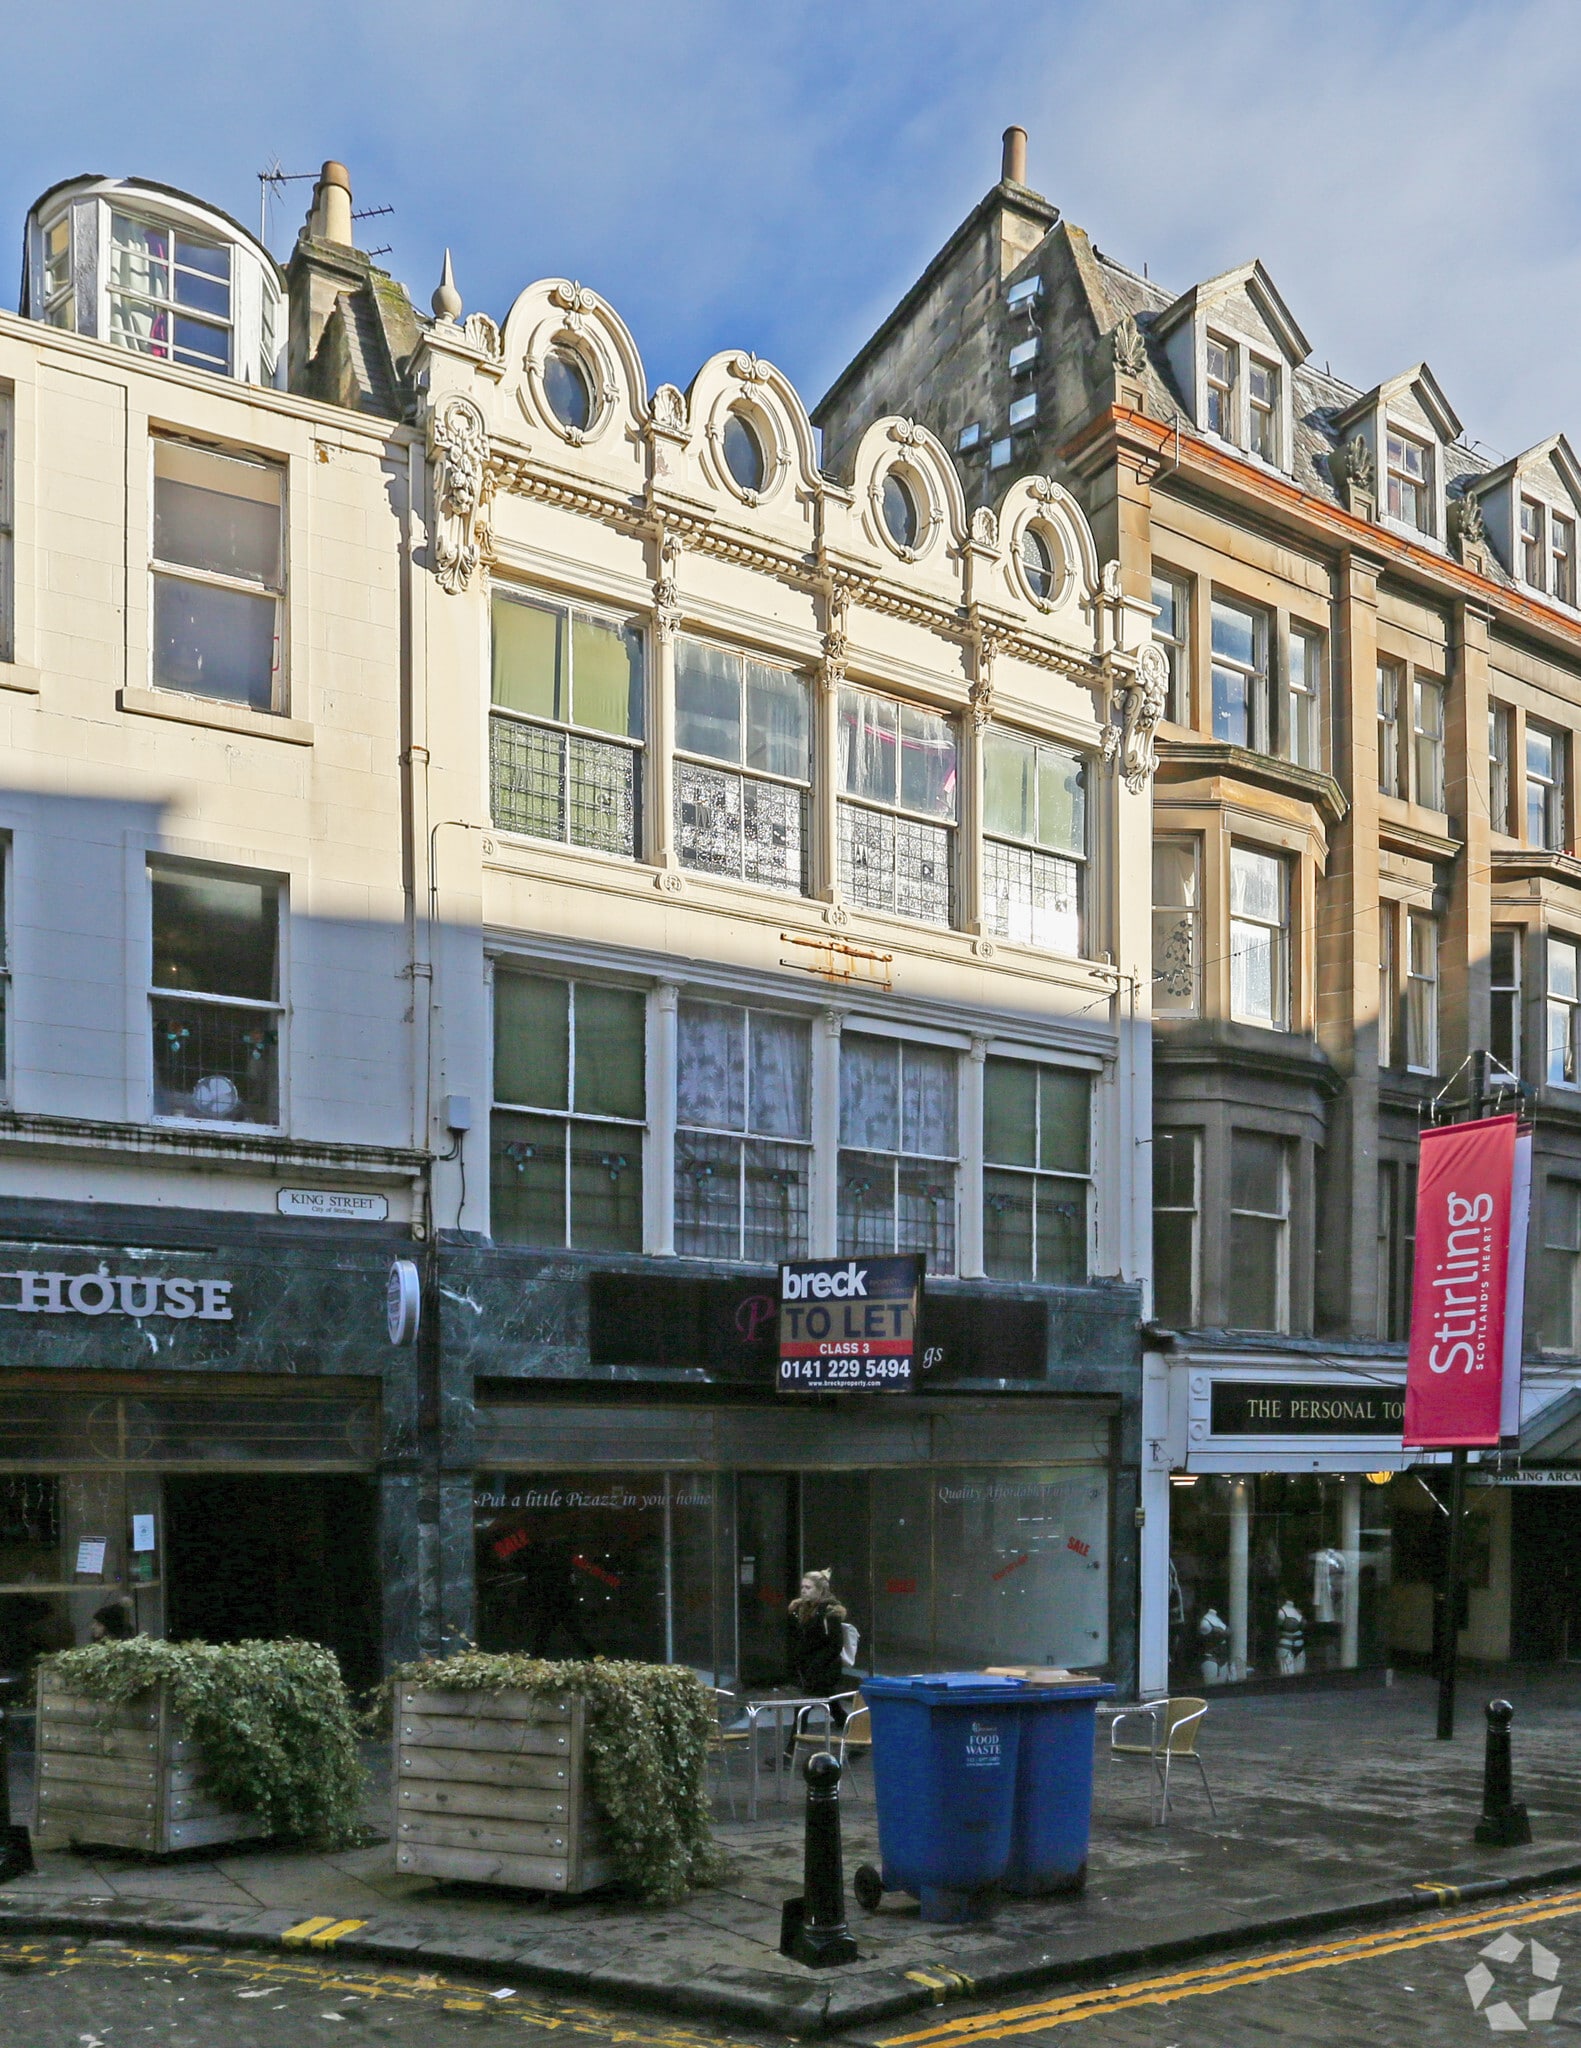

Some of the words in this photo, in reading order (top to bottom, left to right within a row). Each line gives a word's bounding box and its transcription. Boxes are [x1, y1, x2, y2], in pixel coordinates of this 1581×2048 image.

[291, 1193, 324, 1205] KING
[329, 1196, 374, 1209] STREET
[1482, 1226, 1493, 1272] HEART
[782, 1262, 868, 1300] breck
[1429, 1192, 1493, 1374] Stirling
[16, 1270, 234, 1320] HOUSE
[785, 1306, 831, 1340] TO
[844, 1303, 909, 1338] LET
[1476, 1281, 1489, 1370] SCOTLAND'S
[819, 1343, 859, 1355] CLASS
[862, 1343, 870, 1354] 3
[781, 1360, 821, 1379] 0141
[828, 1359, 861, 1378] 229
[865, 1359, 911, 1378] 5494
[808, 1380, 881, 1388] www.breckproperty.com
[1247, 1399, 1282, 1418] THE
[1290, 1400, 1376, 1419] PERSONAL
[1547, 1472, 1581, 1481] ARCA
[477, 1491, 506, 1507] Put
[511, 1495, 522, 1507] a
[525, 1489, 562, 1507] little
[622, 1491, 636, 1505] in
[1067, 1536, 1091, 1557] SALE
[966, 1744, 1001, 1754] WASTE
[970, 1735, 999, 1745] FOOD
